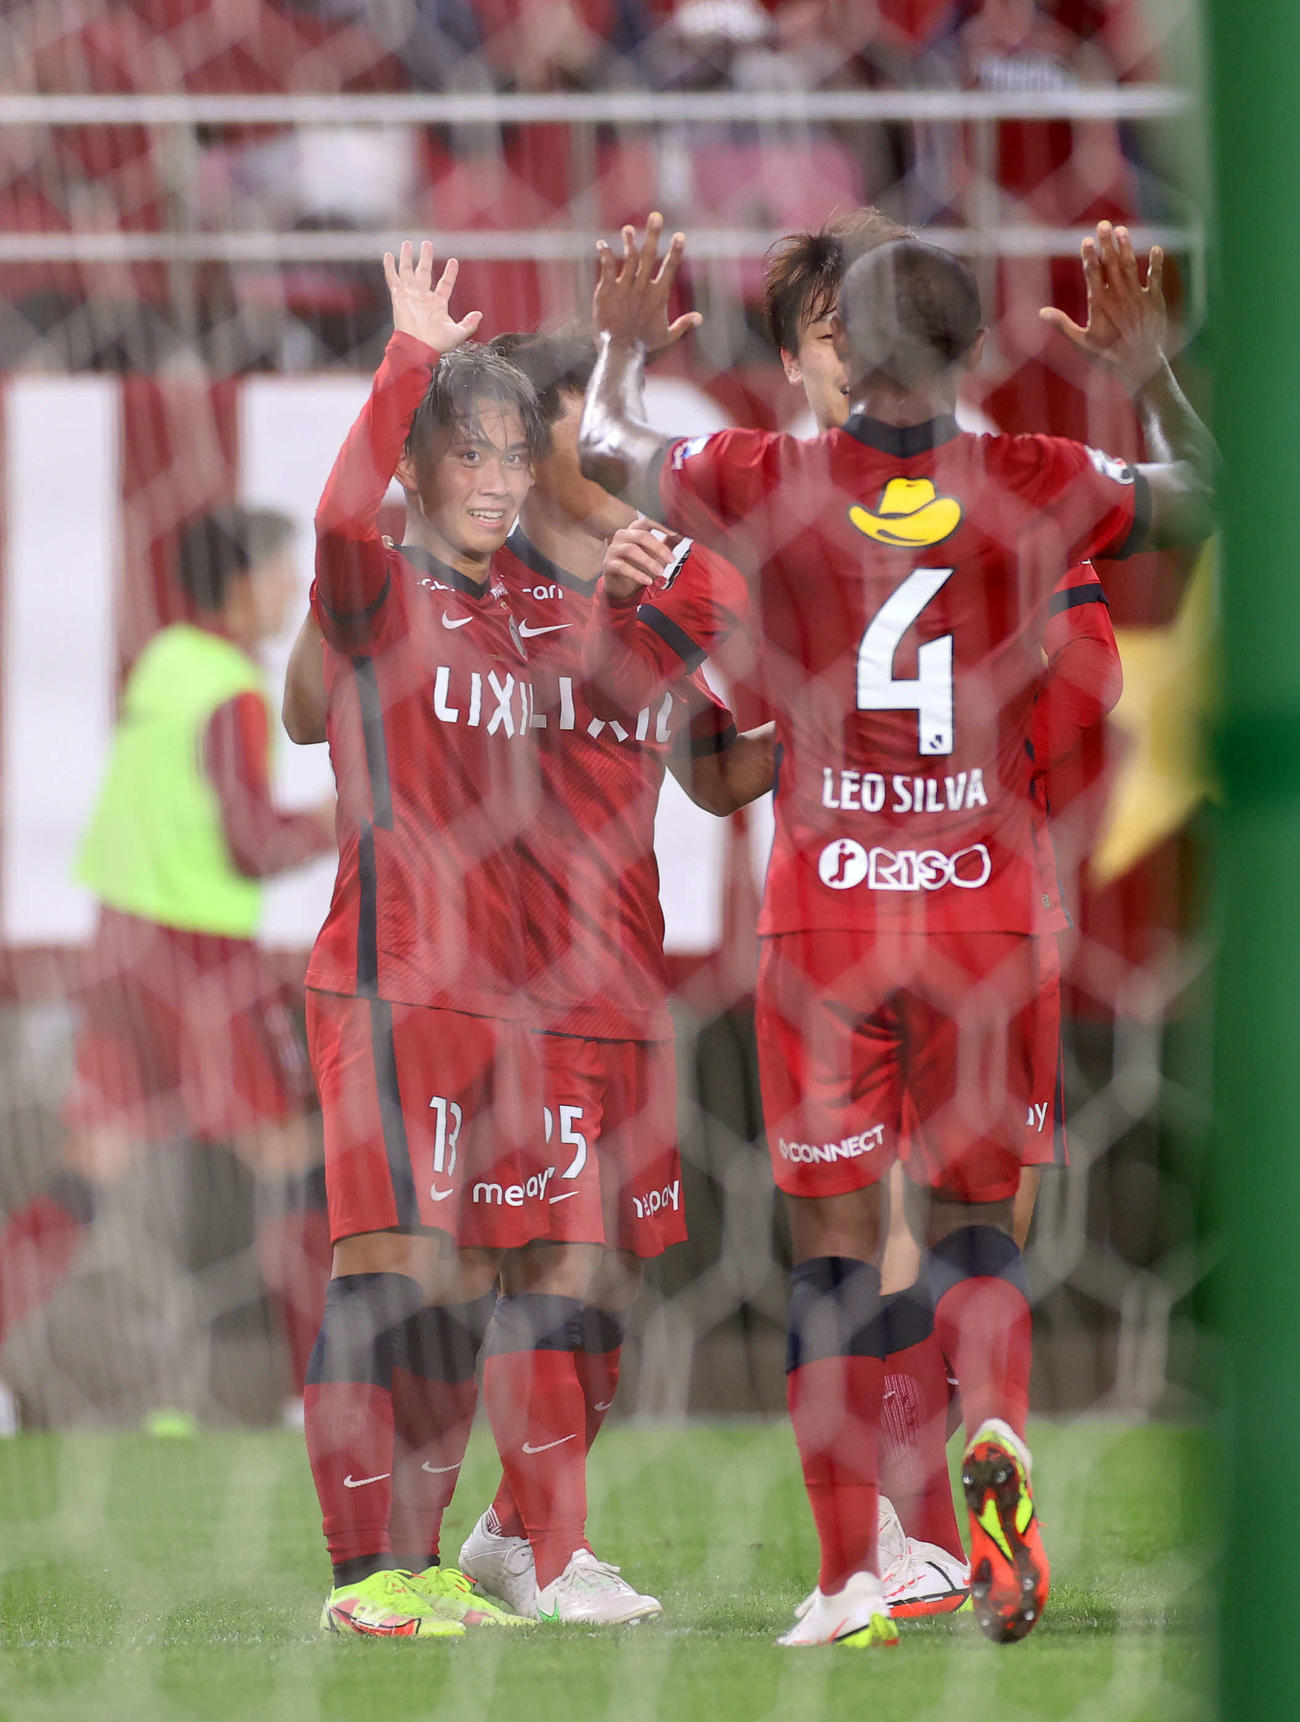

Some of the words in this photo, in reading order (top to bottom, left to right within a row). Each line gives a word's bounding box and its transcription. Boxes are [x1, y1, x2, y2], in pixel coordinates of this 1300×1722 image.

[857, 567, 954, 756] 4
[434, 666, 534, 739] LIXI
[822, 767, 886, 812] LEO
[892, 768, 989, 813] SILVA
[867, 848, 992, 891] RISO
[543, 1104, 588, 1179] 5
